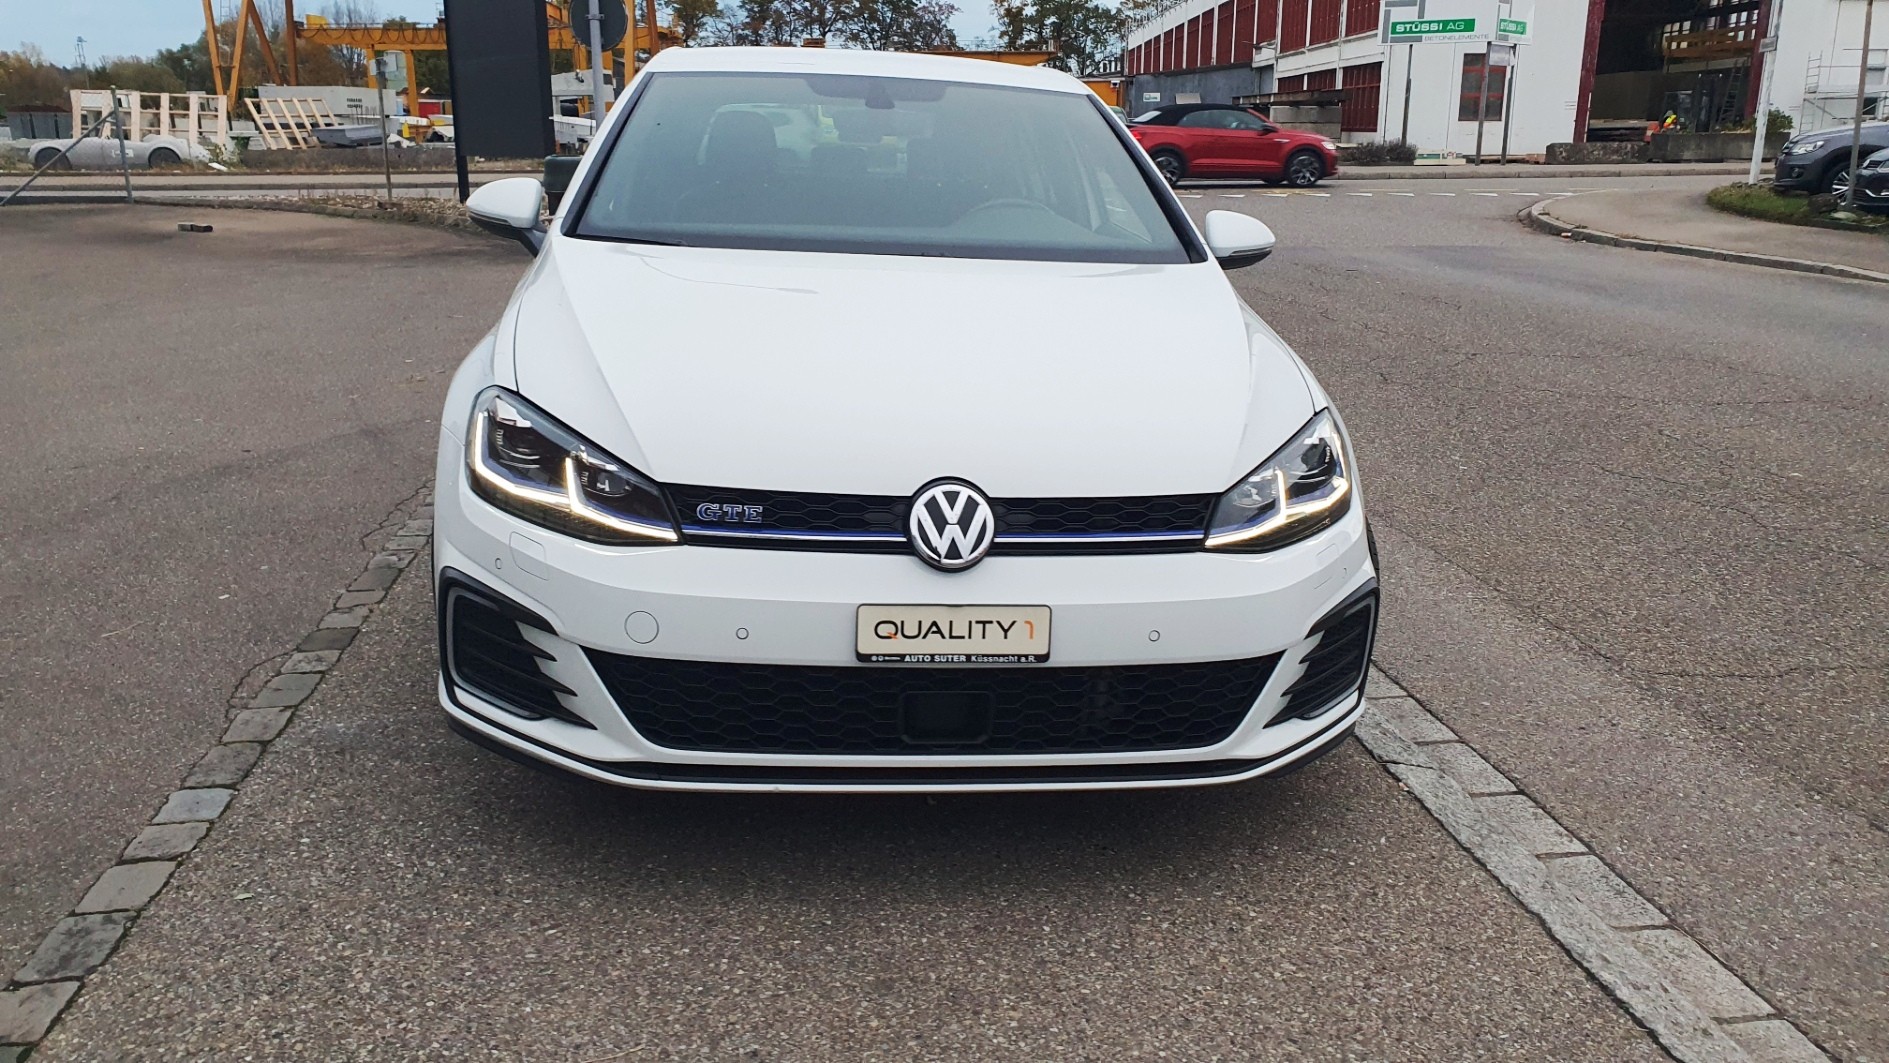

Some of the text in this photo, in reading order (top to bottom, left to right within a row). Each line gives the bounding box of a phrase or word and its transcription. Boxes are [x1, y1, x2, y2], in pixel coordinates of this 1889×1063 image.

[1396, 21, 1465, 32] STÜSSI AG
[1424, 33, 1489, 42] BETONELEMENTE
[696, 502, 763, 523] GTE
[911, 485, 993, 563] VW
[904, 654, 931, 662] AUTO
[934, 654, 966, 662] SUTER
[971, 654, 1018, 662] Küssnacht
